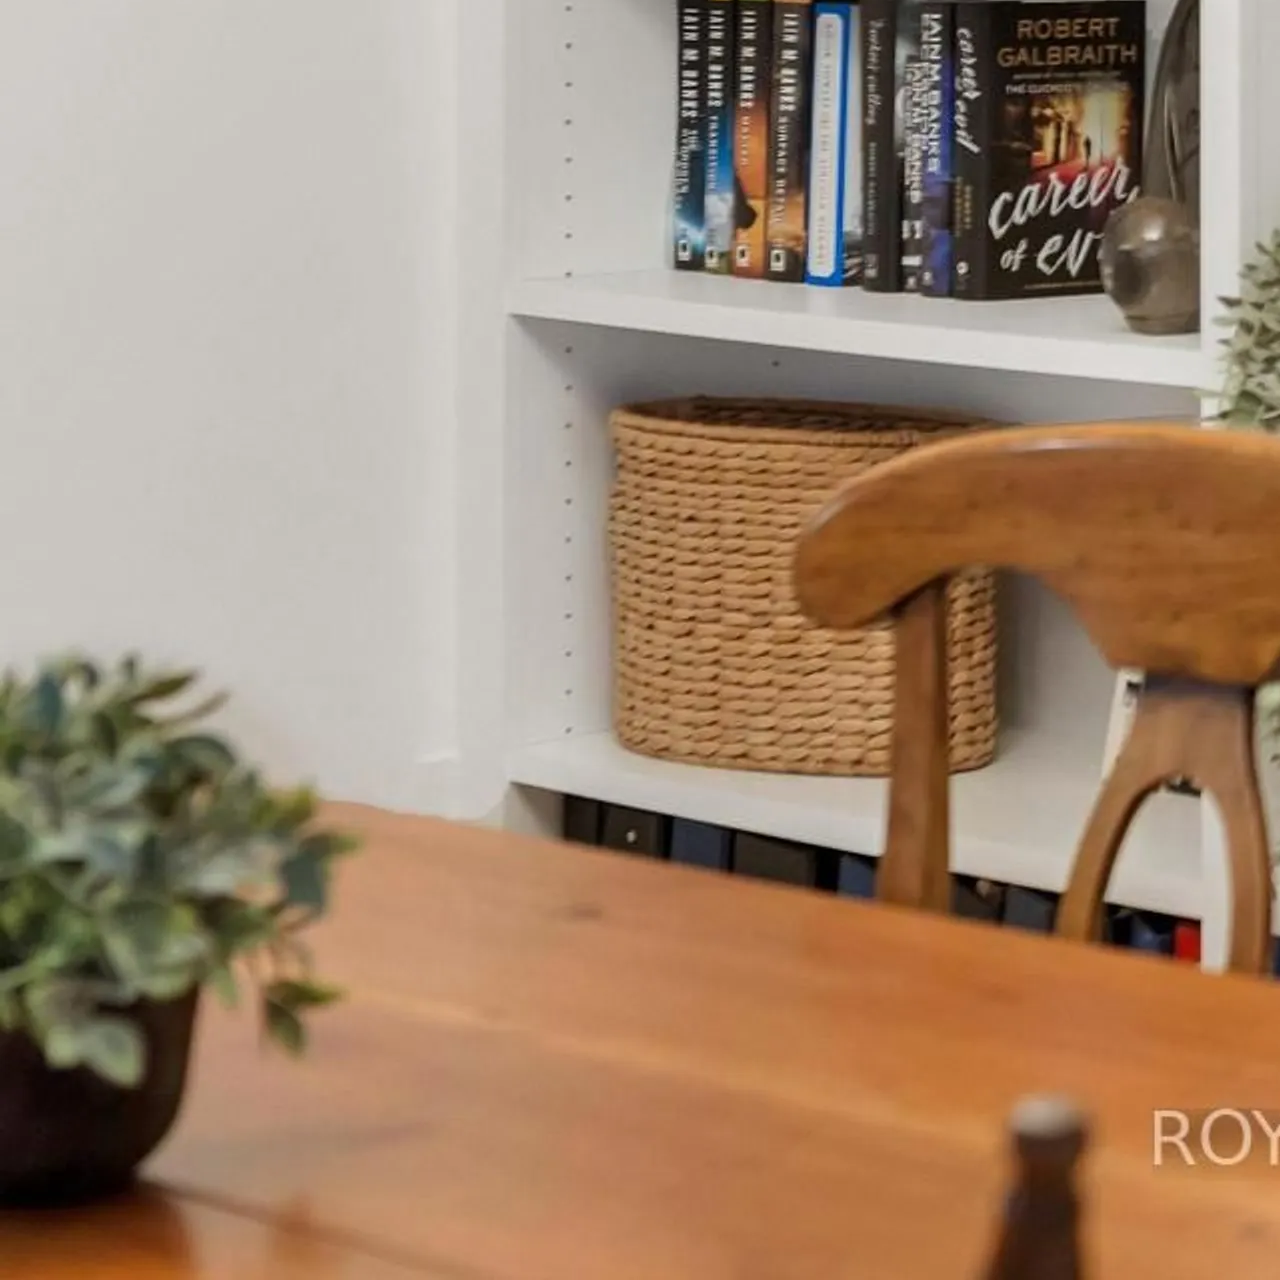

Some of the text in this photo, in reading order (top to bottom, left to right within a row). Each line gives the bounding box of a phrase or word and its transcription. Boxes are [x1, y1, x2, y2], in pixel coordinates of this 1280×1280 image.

[682, 8, 699, 41] IAIN
[708, 10, 724, 40] IAIN
[1017, 17, 1121, 40] ROBERT
[681, 48, 699, 66] M.
[708, 45, 724, 63] M.
[740, 10, 756, 107] IAIN M. BANKS
[997, 44, 1137, 68] GALBRAITH
[707, 65, 723, 107] BANKS
[776, 13, 798, 174] IAIN M. BANKS SURFACE
[925, 13, 943, 173] IAIN BANKS
[910, 133, 923, 204] BANKS
[988, 156, 1140, 240] career
[1000, 228, 1105, 278] of ev
